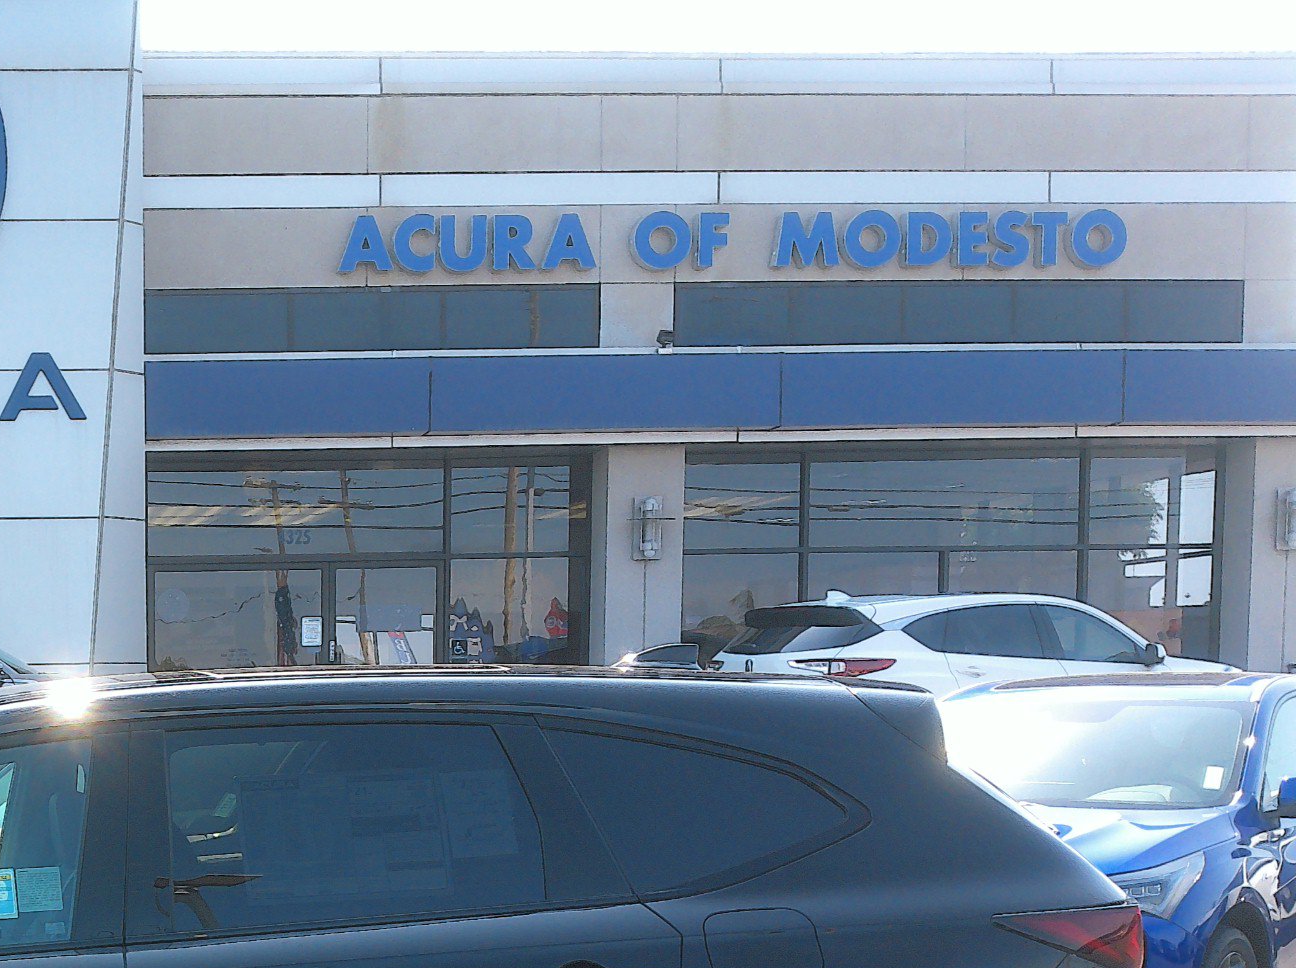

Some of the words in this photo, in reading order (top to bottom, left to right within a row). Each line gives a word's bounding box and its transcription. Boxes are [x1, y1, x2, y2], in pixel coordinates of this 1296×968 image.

[339, 213, 597, 273] ACURA
[630, 211, 731, 270] OF
[771, 208, 1128, 270] MODESTO
